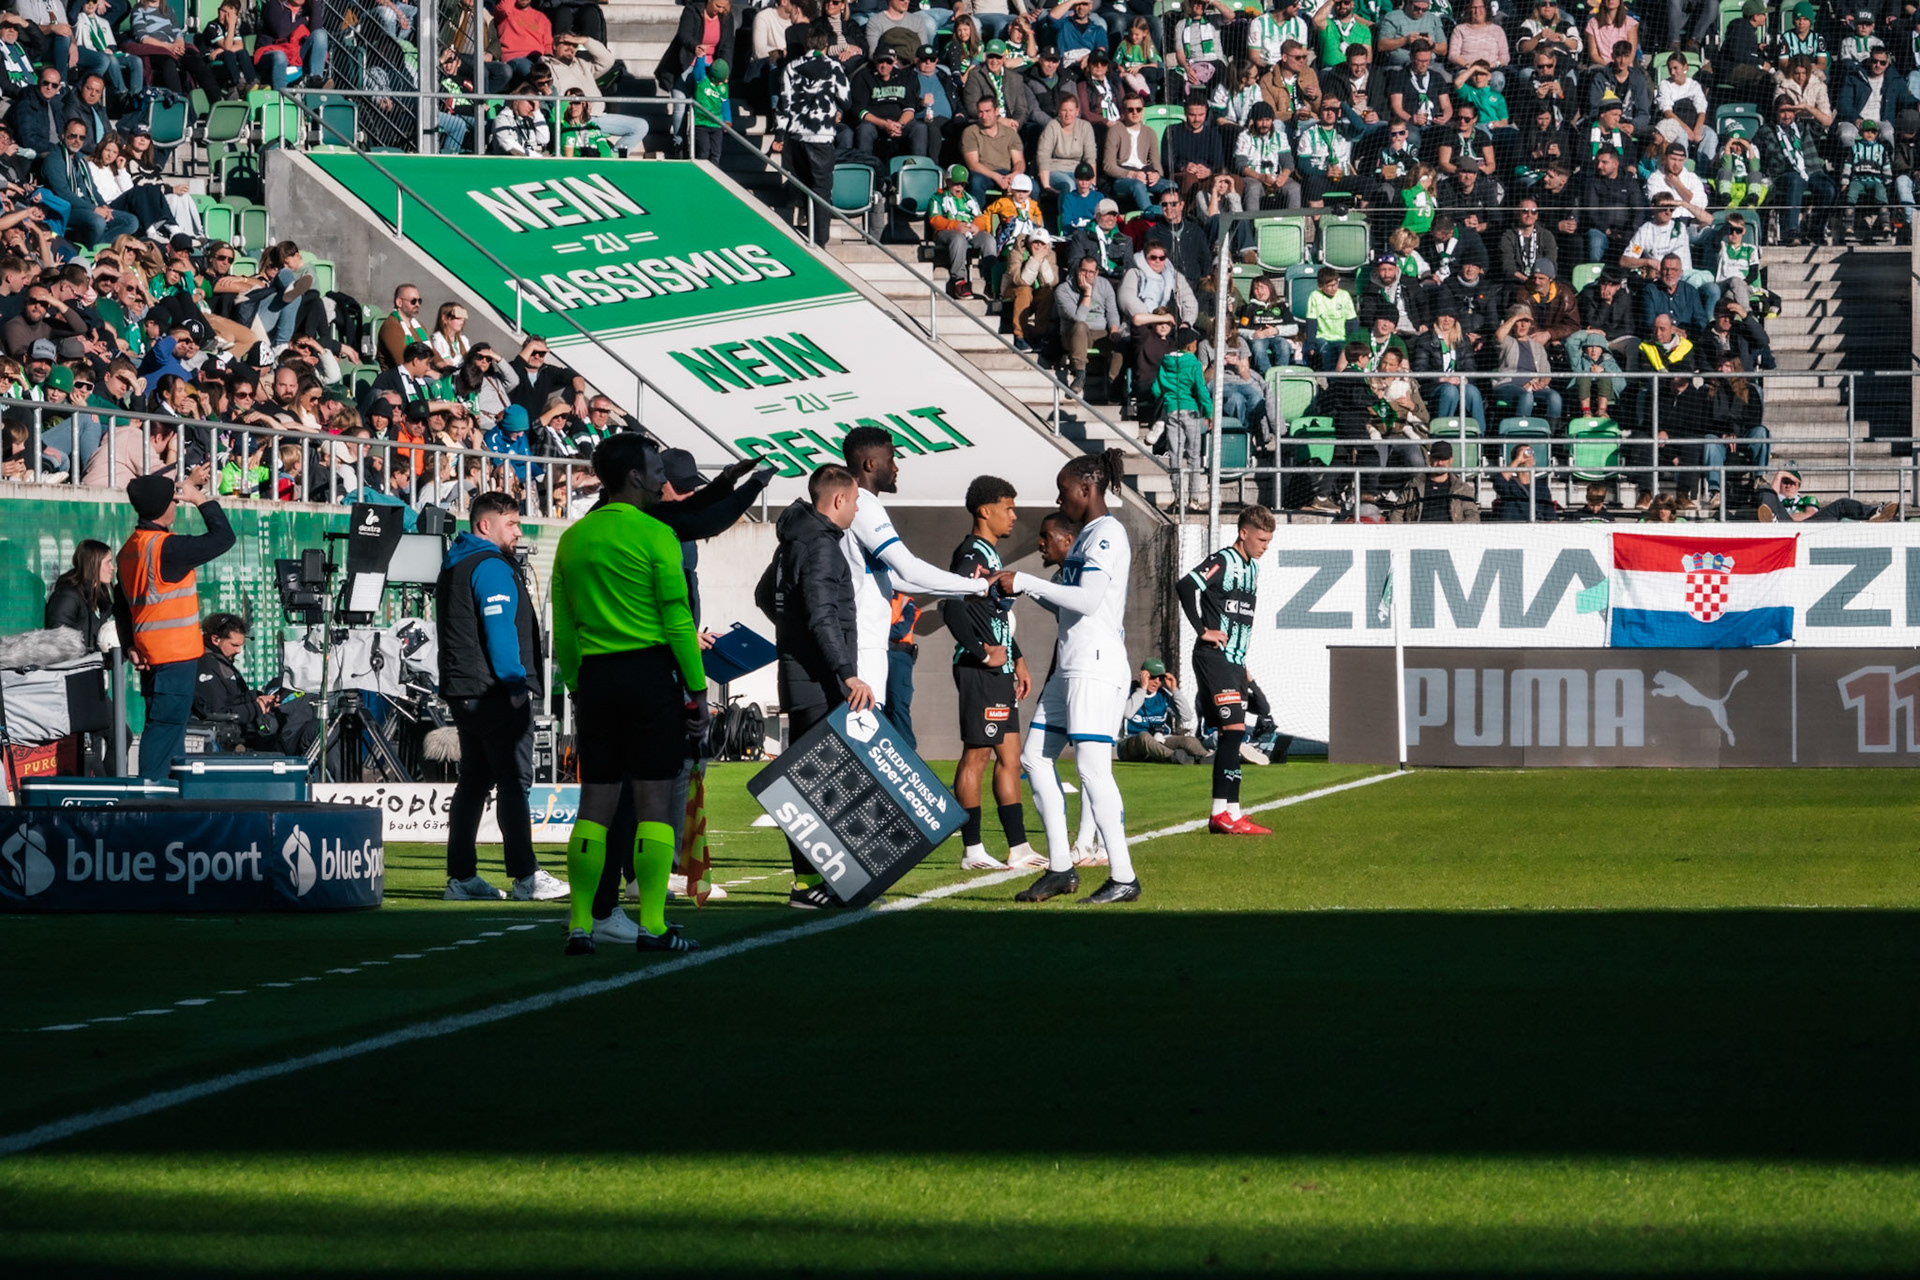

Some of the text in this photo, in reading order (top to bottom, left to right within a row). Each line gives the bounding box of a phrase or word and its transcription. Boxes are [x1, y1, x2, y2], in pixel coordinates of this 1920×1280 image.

[466, 173, 650, 233] NEIN
[582, 232, 630, 254] ZU
[505, 244, 796, 313] RASSISMUS
[667, 332, 851, 393] NEIN
[784, 392, 830, 414] ZU
[1403, 668, 1645, 747] PUMA
[868, 746, 941, 831] Super League
[66, 839, 263, 895] blue Sport
[321, 838, 364, 880] blue
[775, 801, 847, 882] sfl.ch
